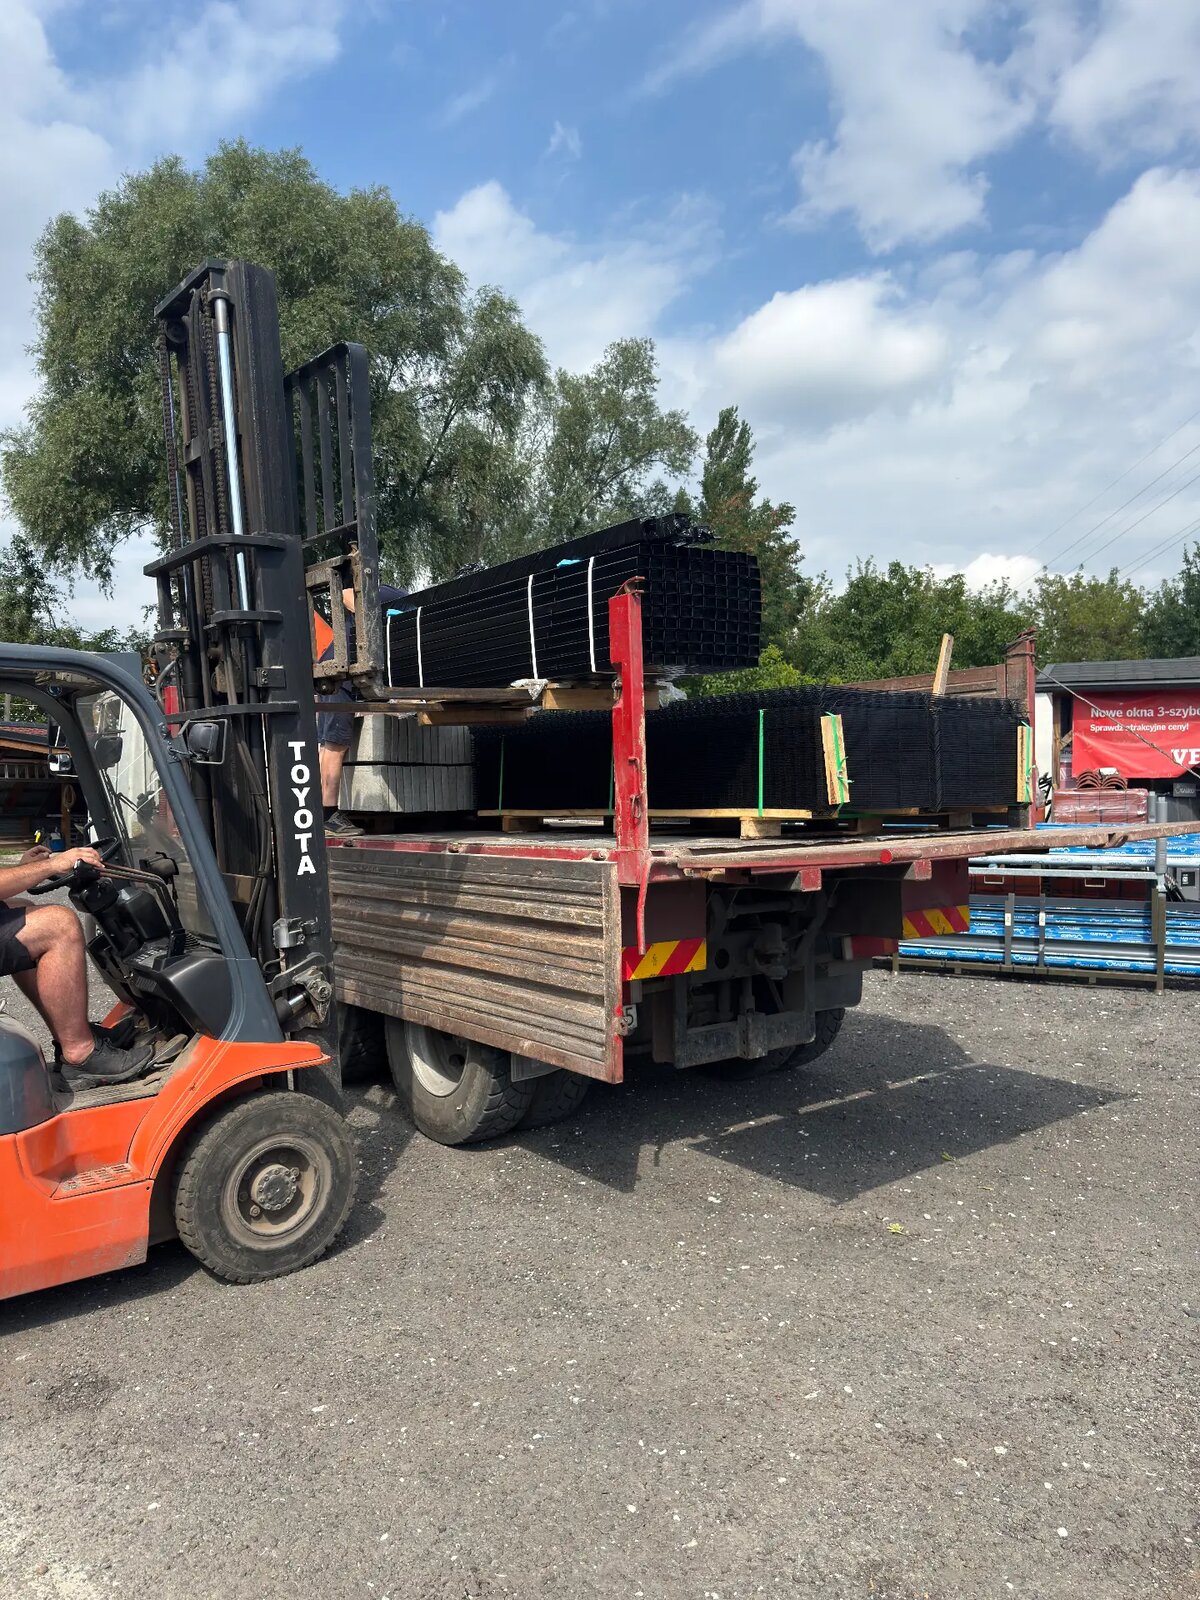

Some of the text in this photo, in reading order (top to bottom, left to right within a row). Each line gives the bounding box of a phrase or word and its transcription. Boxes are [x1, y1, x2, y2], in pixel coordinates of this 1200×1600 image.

[1090, 707, 1123, 718] Nowe
[1126, 707, 1154, 717] okna
[1126, 723, 1166, 733] atrakcyjne
[1167, 722, 1189, 732] ceny!
[287, 741, 317, 876] TOYOTA
